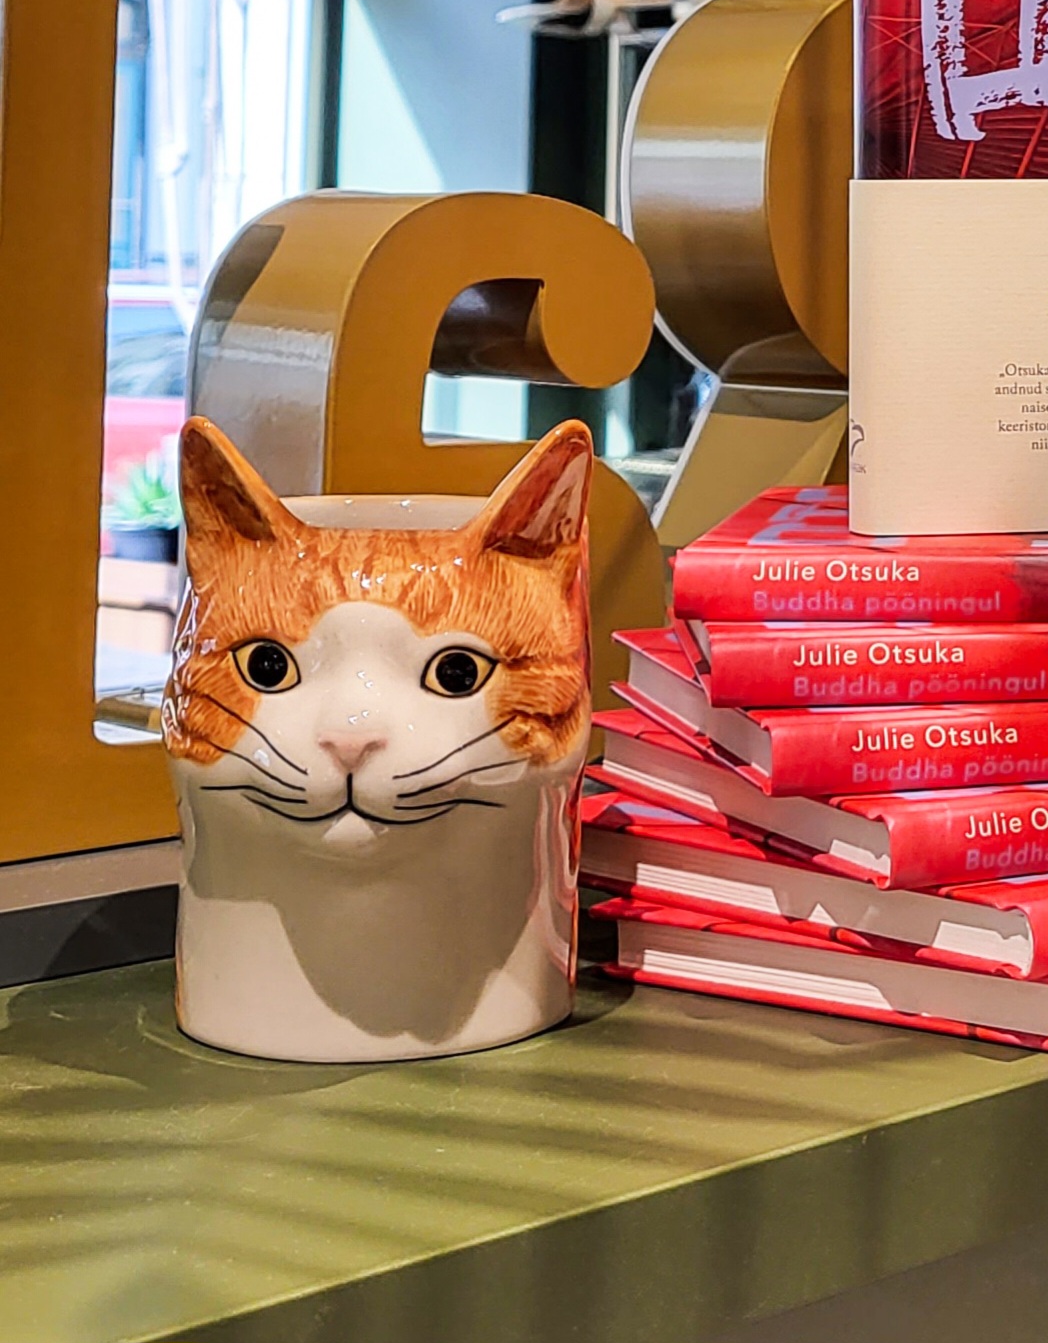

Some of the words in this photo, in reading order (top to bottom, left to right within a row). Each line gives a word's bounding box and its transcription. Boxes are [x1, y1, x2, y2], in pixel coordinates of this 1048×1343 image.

[994, 382, 1042, 395] andnud
[1031, 438, 1048, 450] nii
[753, 559, 816, 582] Julie
[826, 559, 920, 582] Otsuka
[753, 591, 854, 613] Buddha
[866, 591, 1001, 615] pööningul
[794, 644, 858, 667] Julie
[868, 642, 965, 666] Otsuka
[794, 675, 898, 698] Buddha
[909, 671, 1047, 699] pööningul
[852, 728, 915, 753] Julie
[924, 723, 1019, 748] Otsuka
[852, 761, 954, 784] Buddha
[965, 814, 1023, 840] Julie
